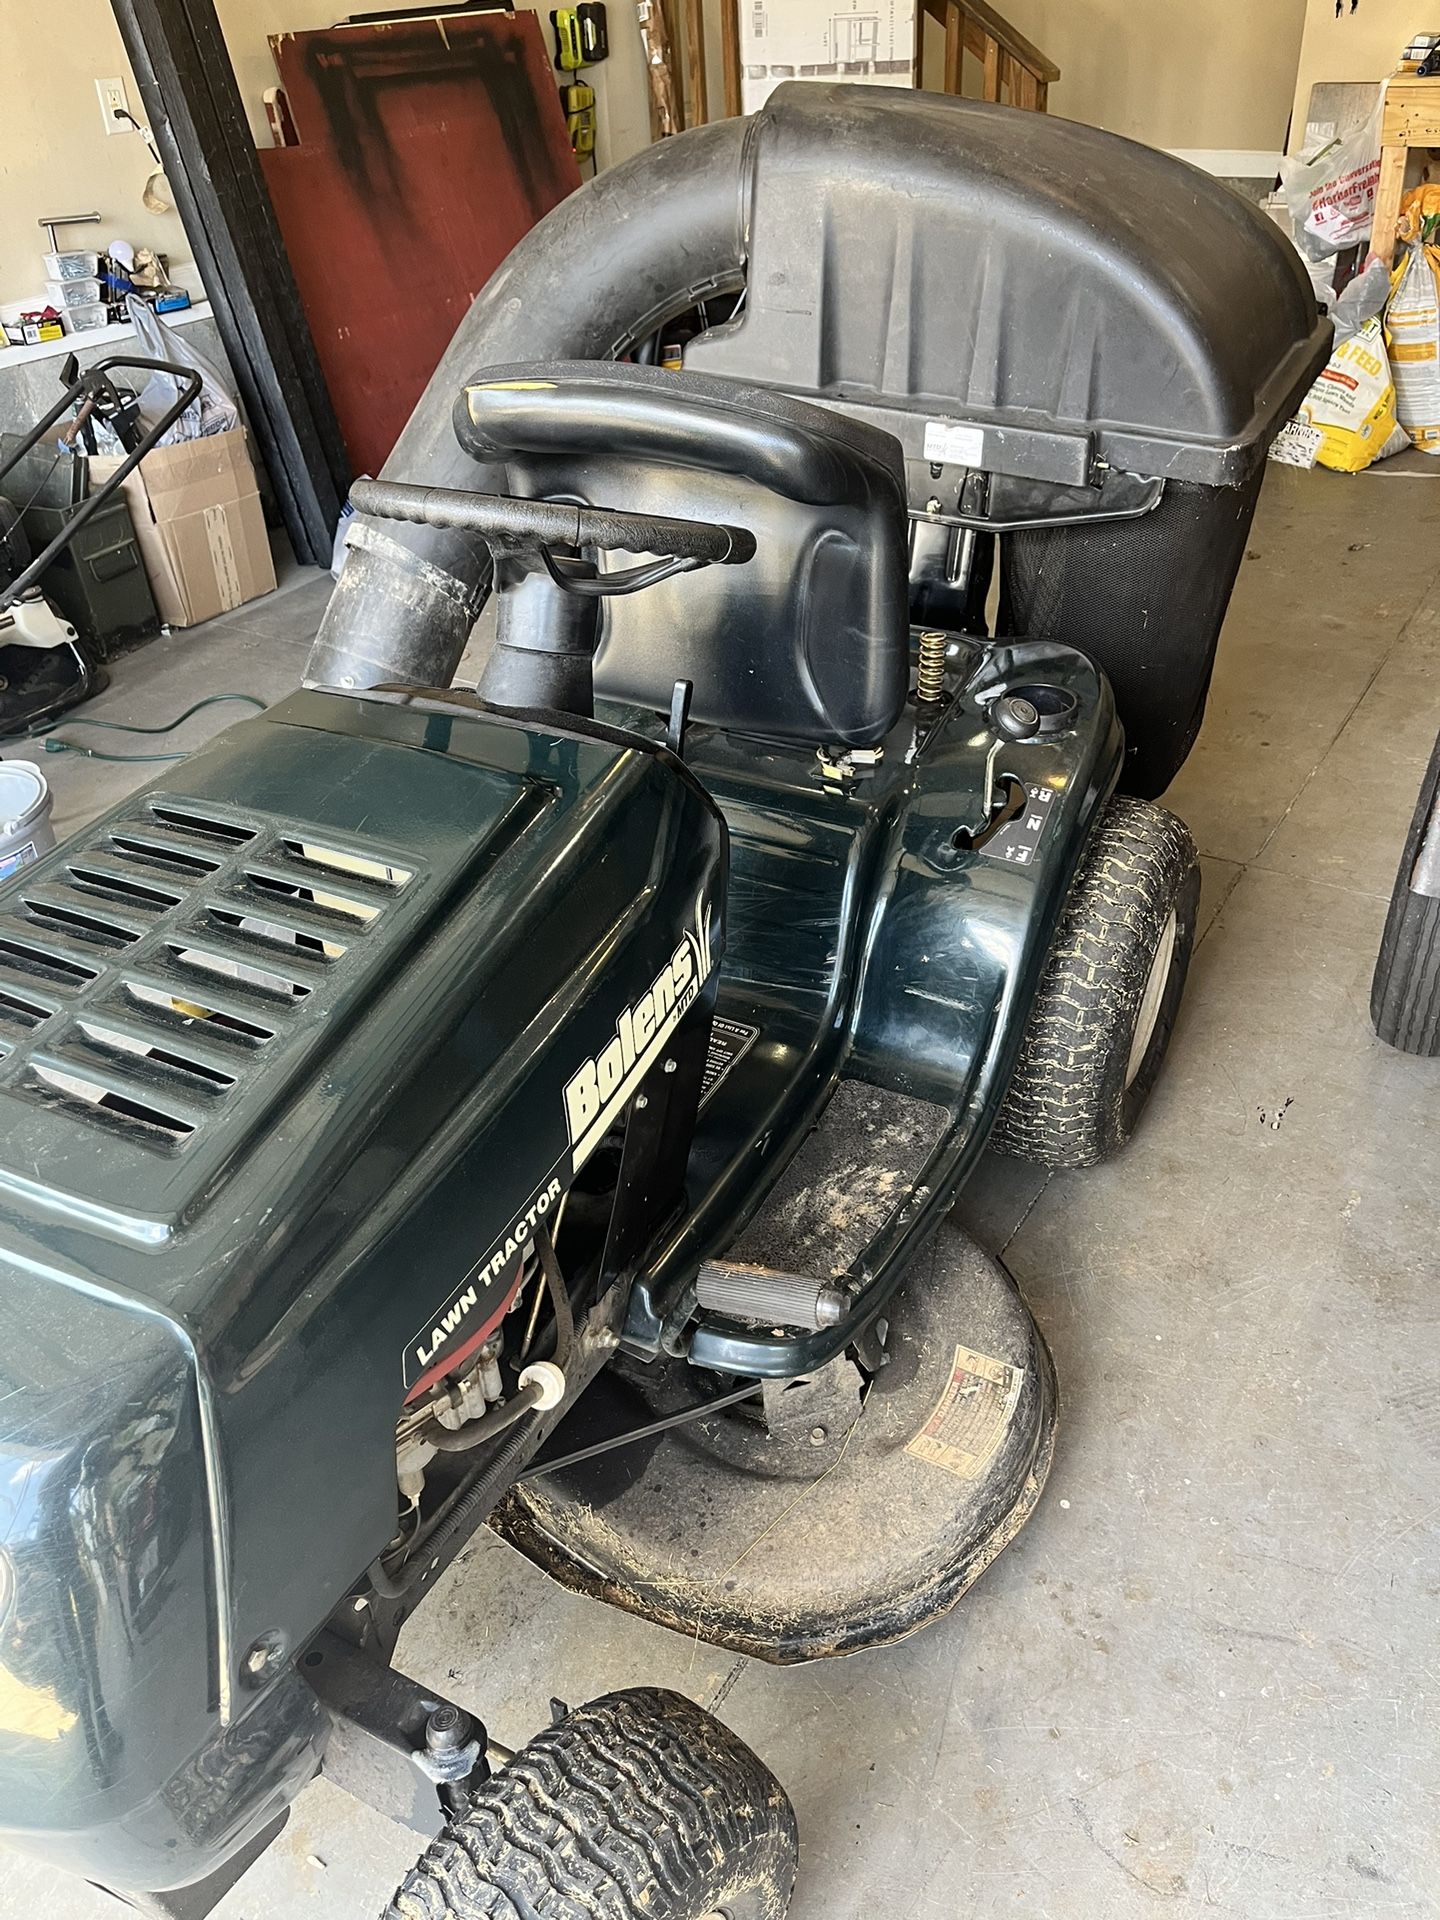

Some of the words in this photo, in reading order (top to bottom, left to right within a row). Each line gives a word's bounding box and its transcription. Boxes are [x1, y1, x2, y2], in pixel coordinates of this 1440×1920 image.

[1339, 160, 1381, 184] Conversatio
[1312, 172, 1380, 211] #HarborFreigh
[1351, 344, 1382, 376] FEED
[1038, 791, 1051, 803] R
[1026, 817, 1041, 831] N
[1015, 850, 1028, 863] F
[677, 985, 694, 1019] MTD
[565, 939, 693, 1146] Bolens
[415, 1285, 478, 1366] LAWN
[478, 1177, 562, 1287] TRACTOR
